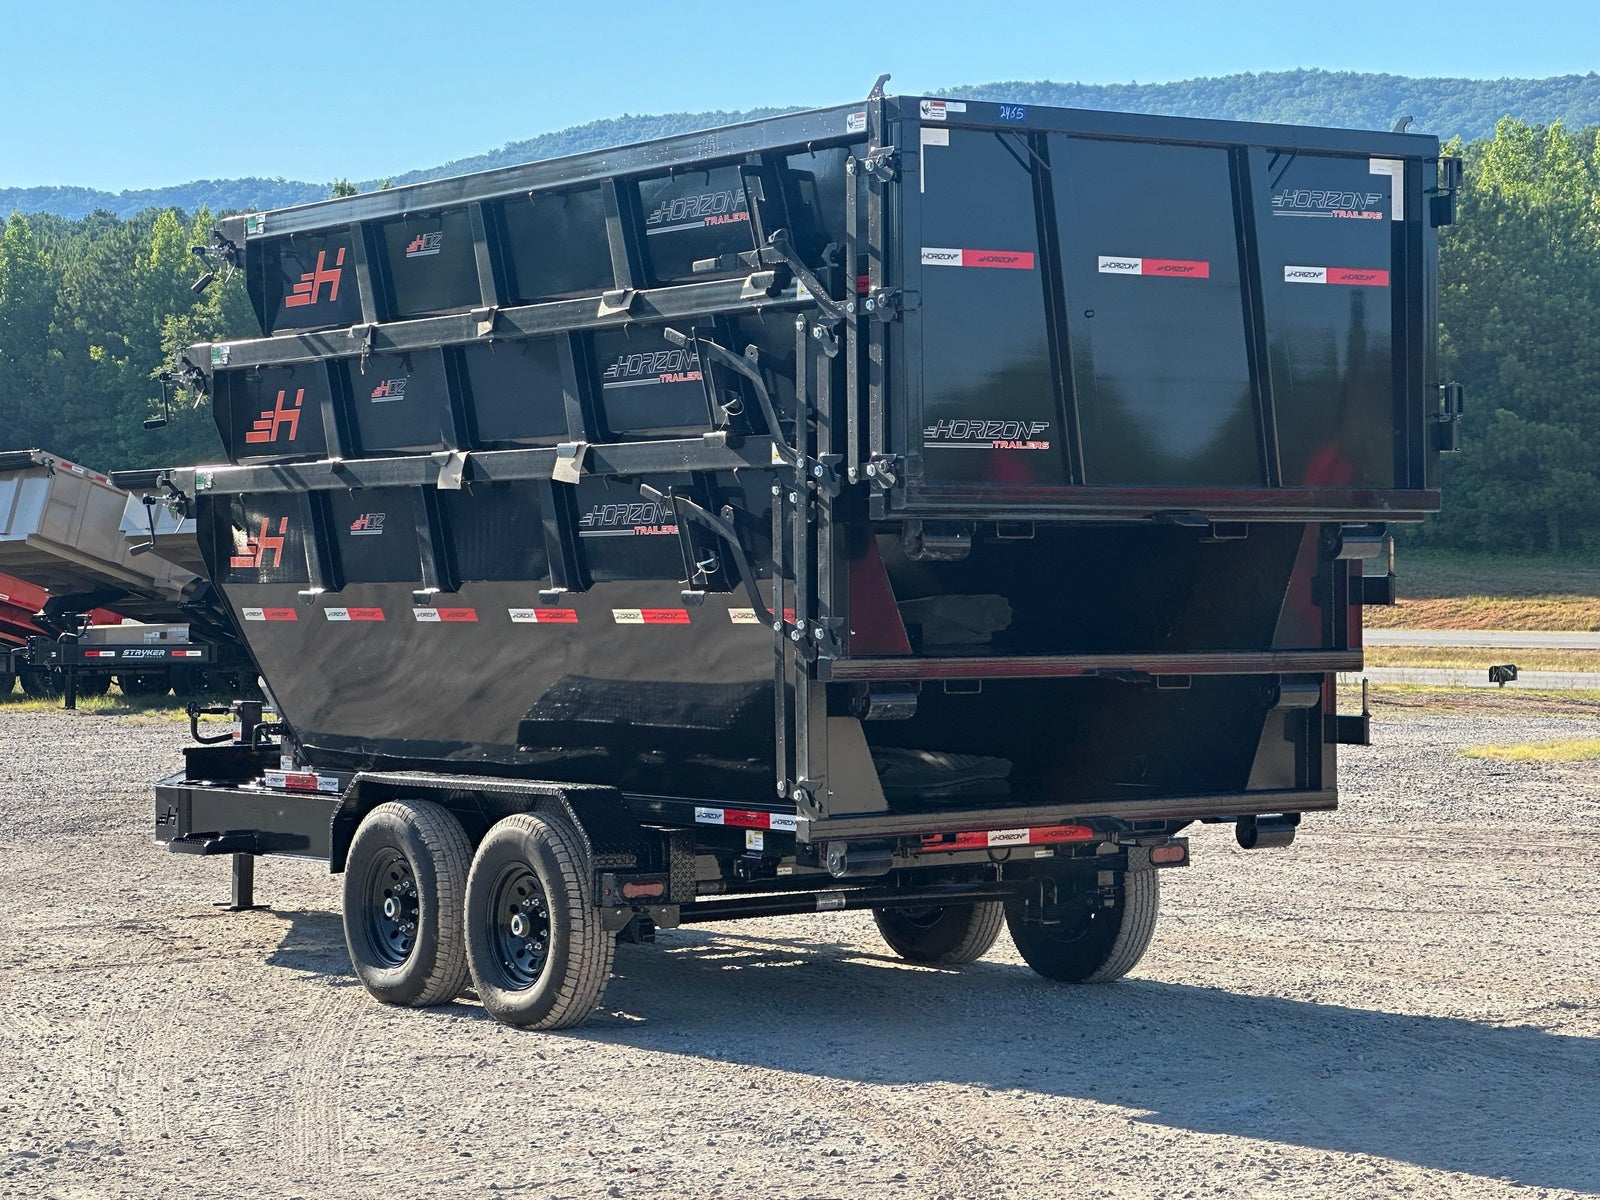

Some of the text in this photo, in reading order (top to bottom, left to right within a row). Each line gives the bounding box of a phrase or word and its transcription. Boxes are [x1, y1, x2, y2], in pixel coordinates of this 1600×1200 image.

[1000, 105, 1024, 120] 2465
[1271, 189, 1382, 209] HORIZON
[647, 187, 752, 224] HORIZON
[1332, 209, 1383, 220] TRAILERS
[922, 252, 959, 260] HORIZON
[1101, 261, 1195, 273] HORIZON HORIZON
[1286, 270, 1323, 279] HORIZON
[603, 349, 699, 379] HORIZON
[923, 419, 1050, 440] HORIZON
[992, 440, 1050, 450] TRAILERS
[579, 502, 673, 526] HORIZON
[122, 649, 166, 657] STRYKER
[990, 832, 1028, 842] HORIZON
